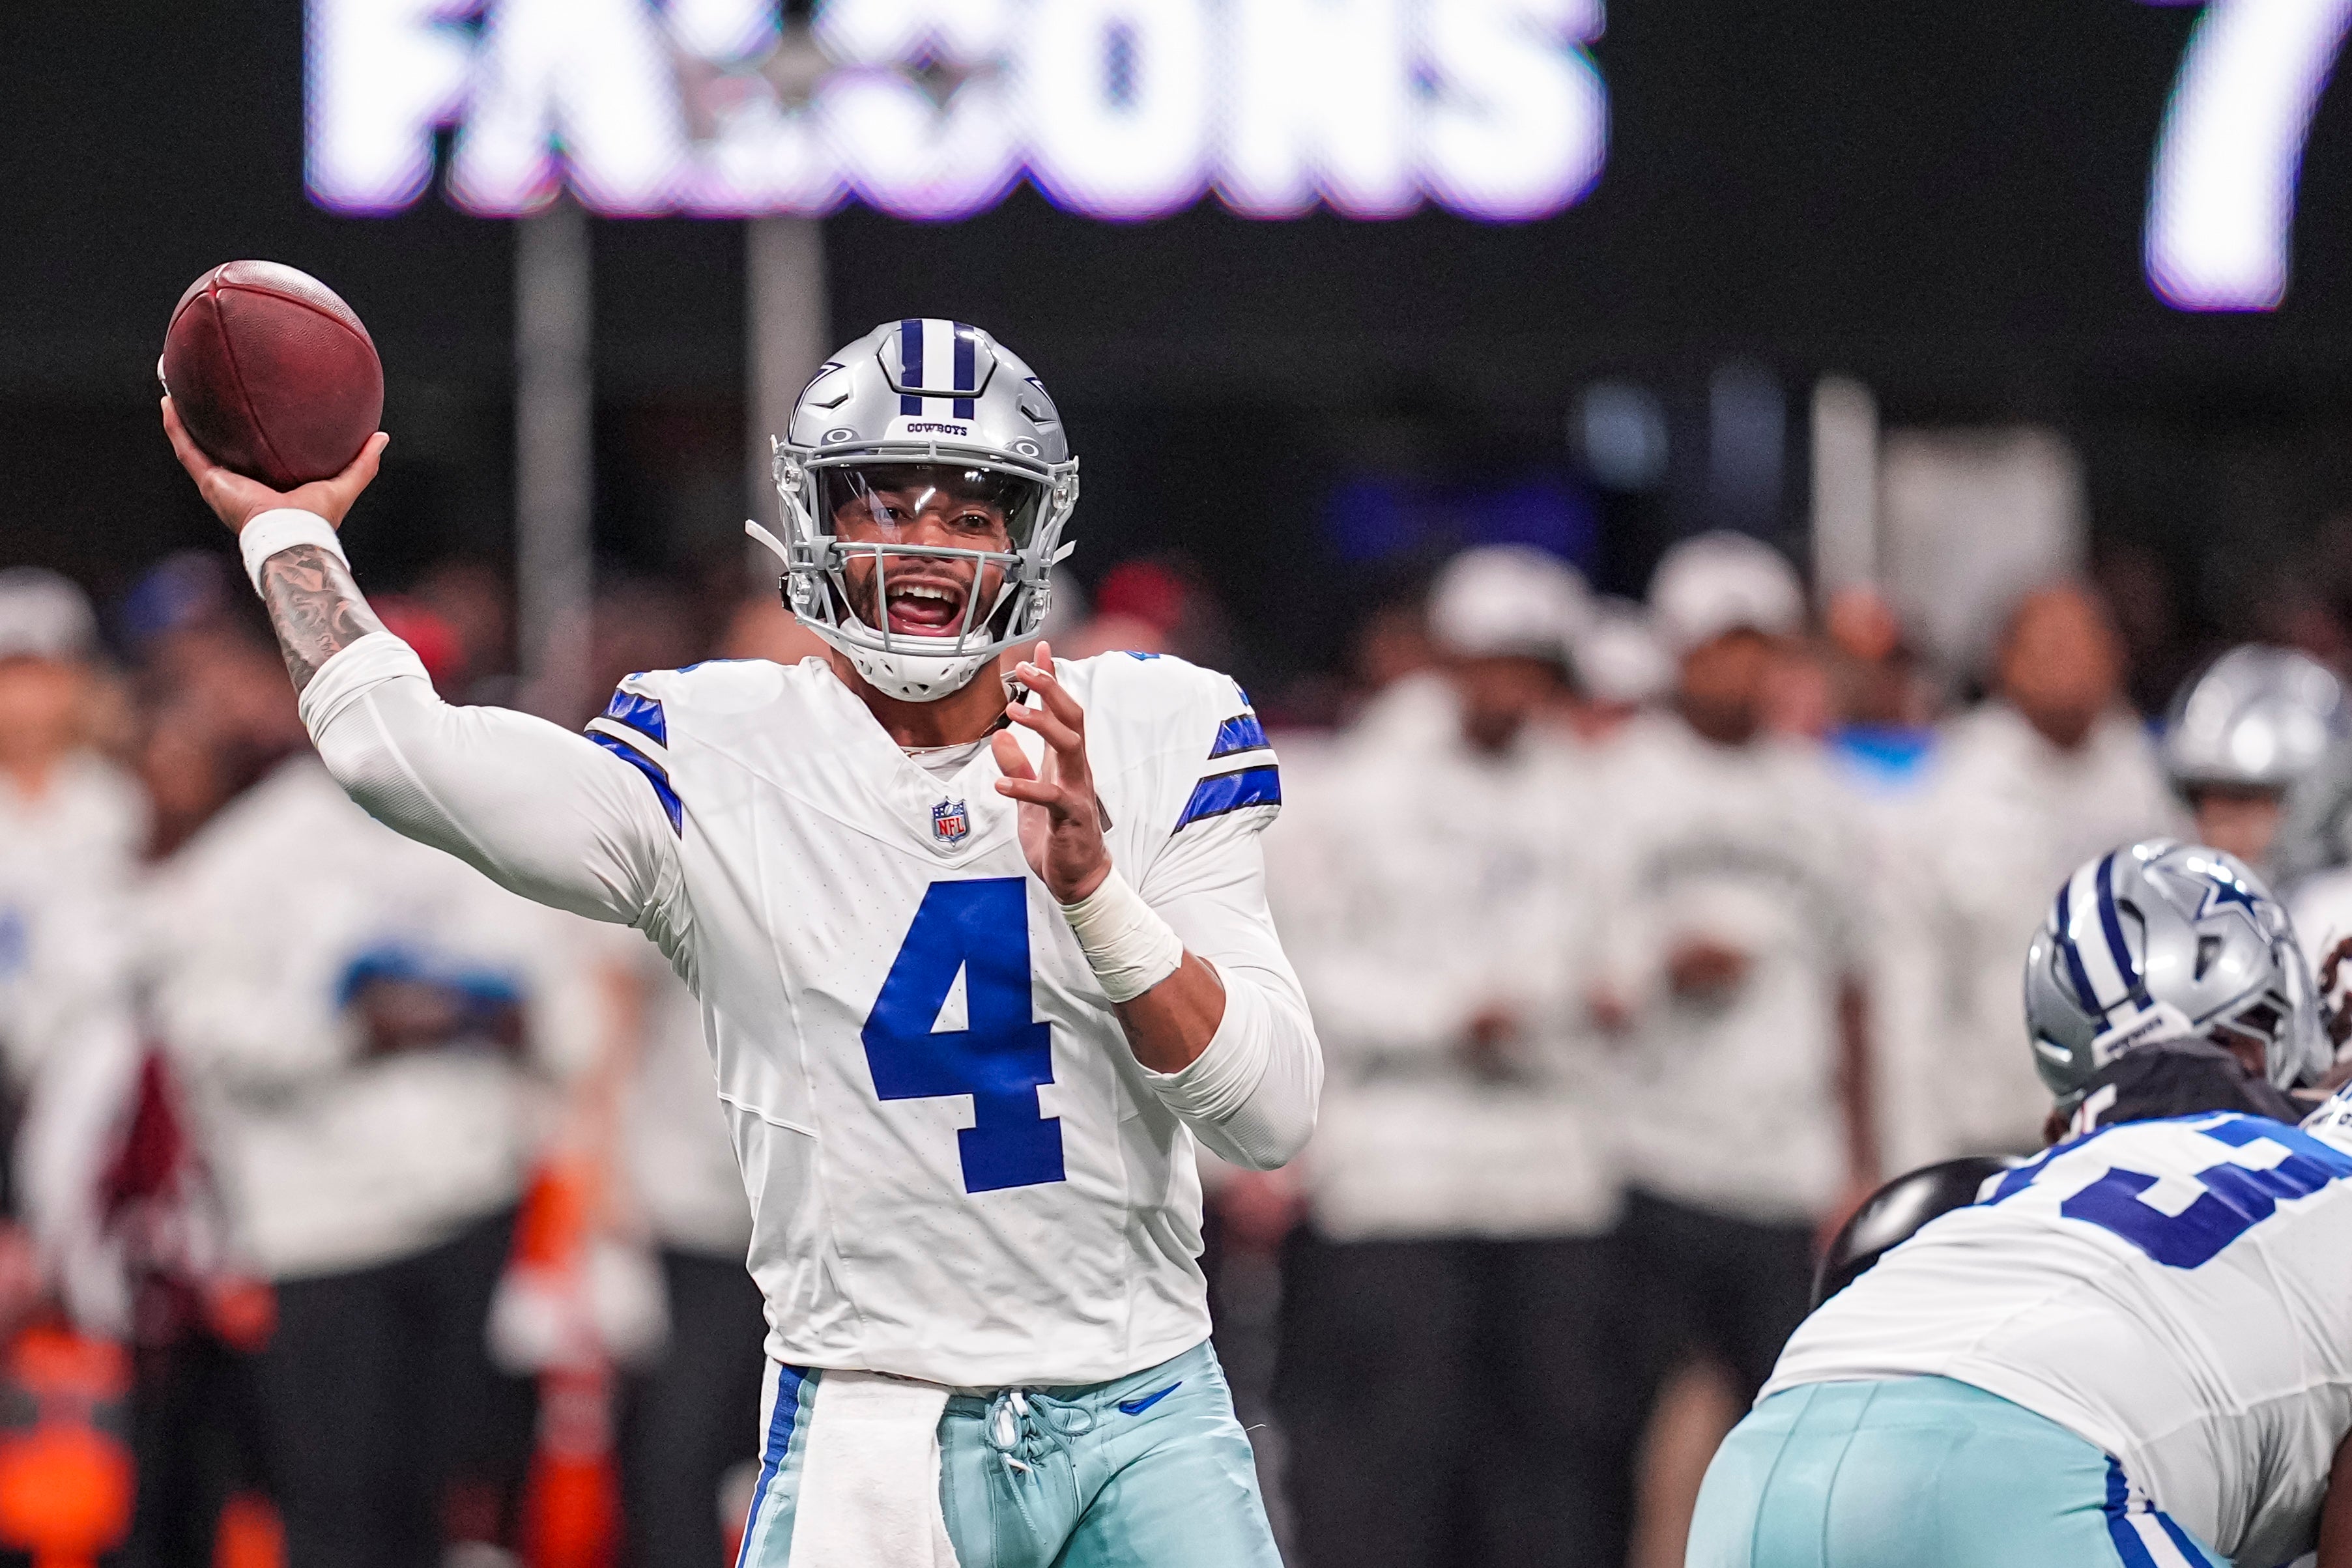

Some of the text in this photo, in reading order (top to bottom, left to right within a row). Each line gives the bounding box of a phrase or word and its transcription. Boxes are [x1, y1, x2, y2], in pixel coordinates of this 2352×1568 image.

[907, 423, 968, 436] COWBOYS
[937, 818, 965, 836] NFL
[862, 877, 1066, 1193] 4
